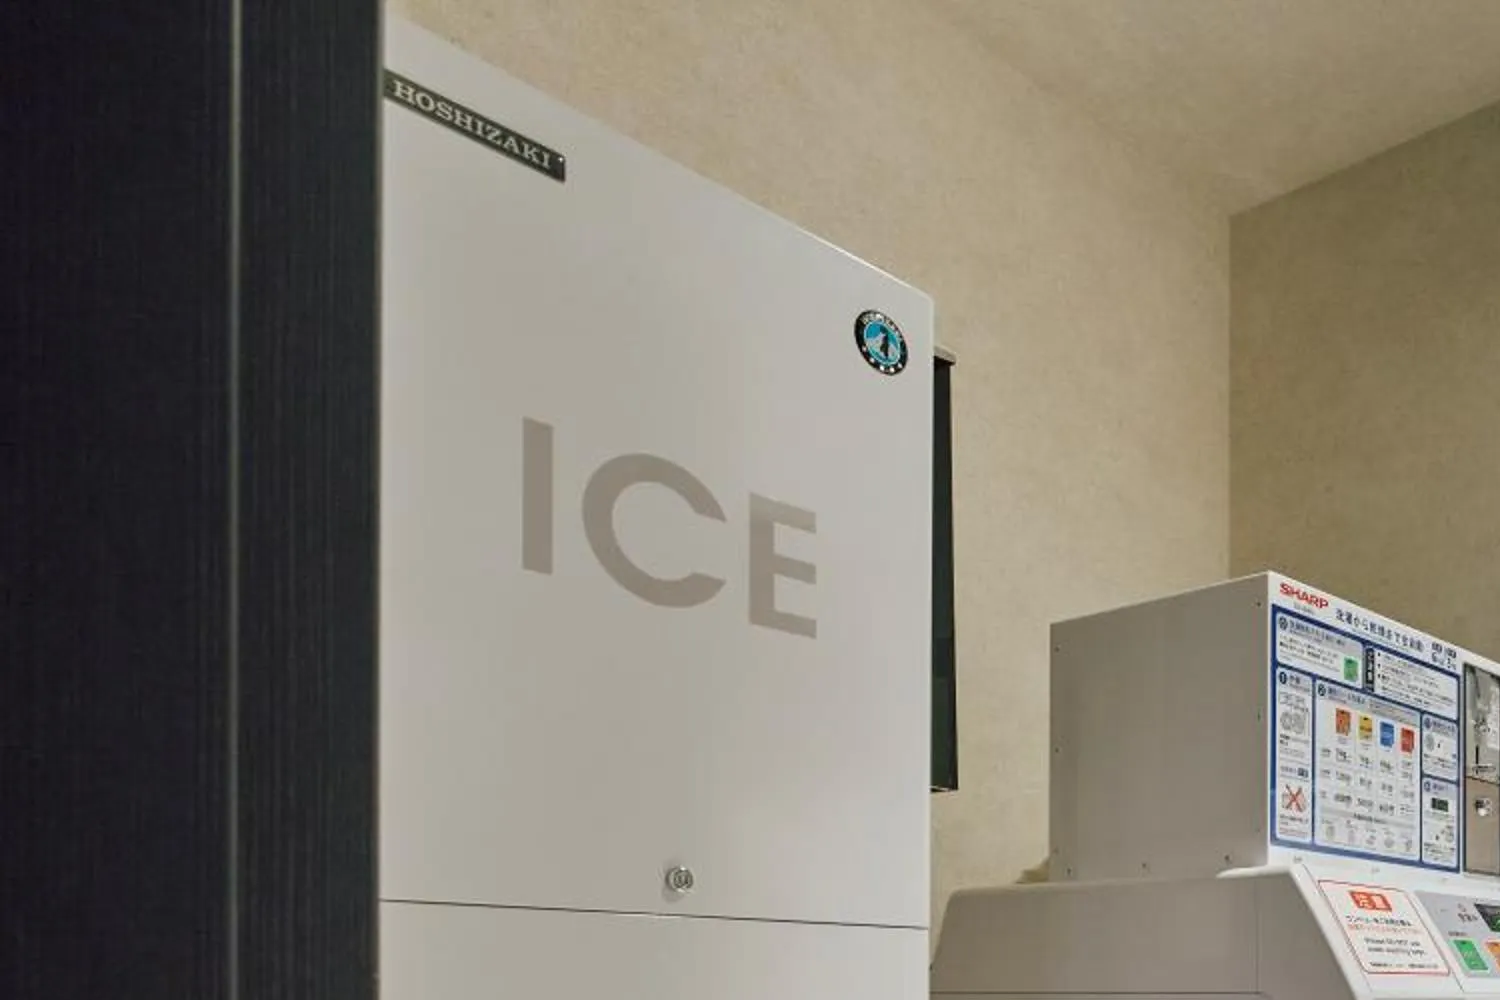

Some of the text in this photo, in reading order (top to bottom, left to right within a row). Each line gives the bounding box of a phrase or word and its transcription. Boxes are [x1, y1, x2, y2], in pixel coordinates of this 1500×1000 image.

[393, 79, 551, 169] HOSHIZAKI
[522, 416, 817, 639] ICE
[1279, 582, 1329, 609] SHARP
